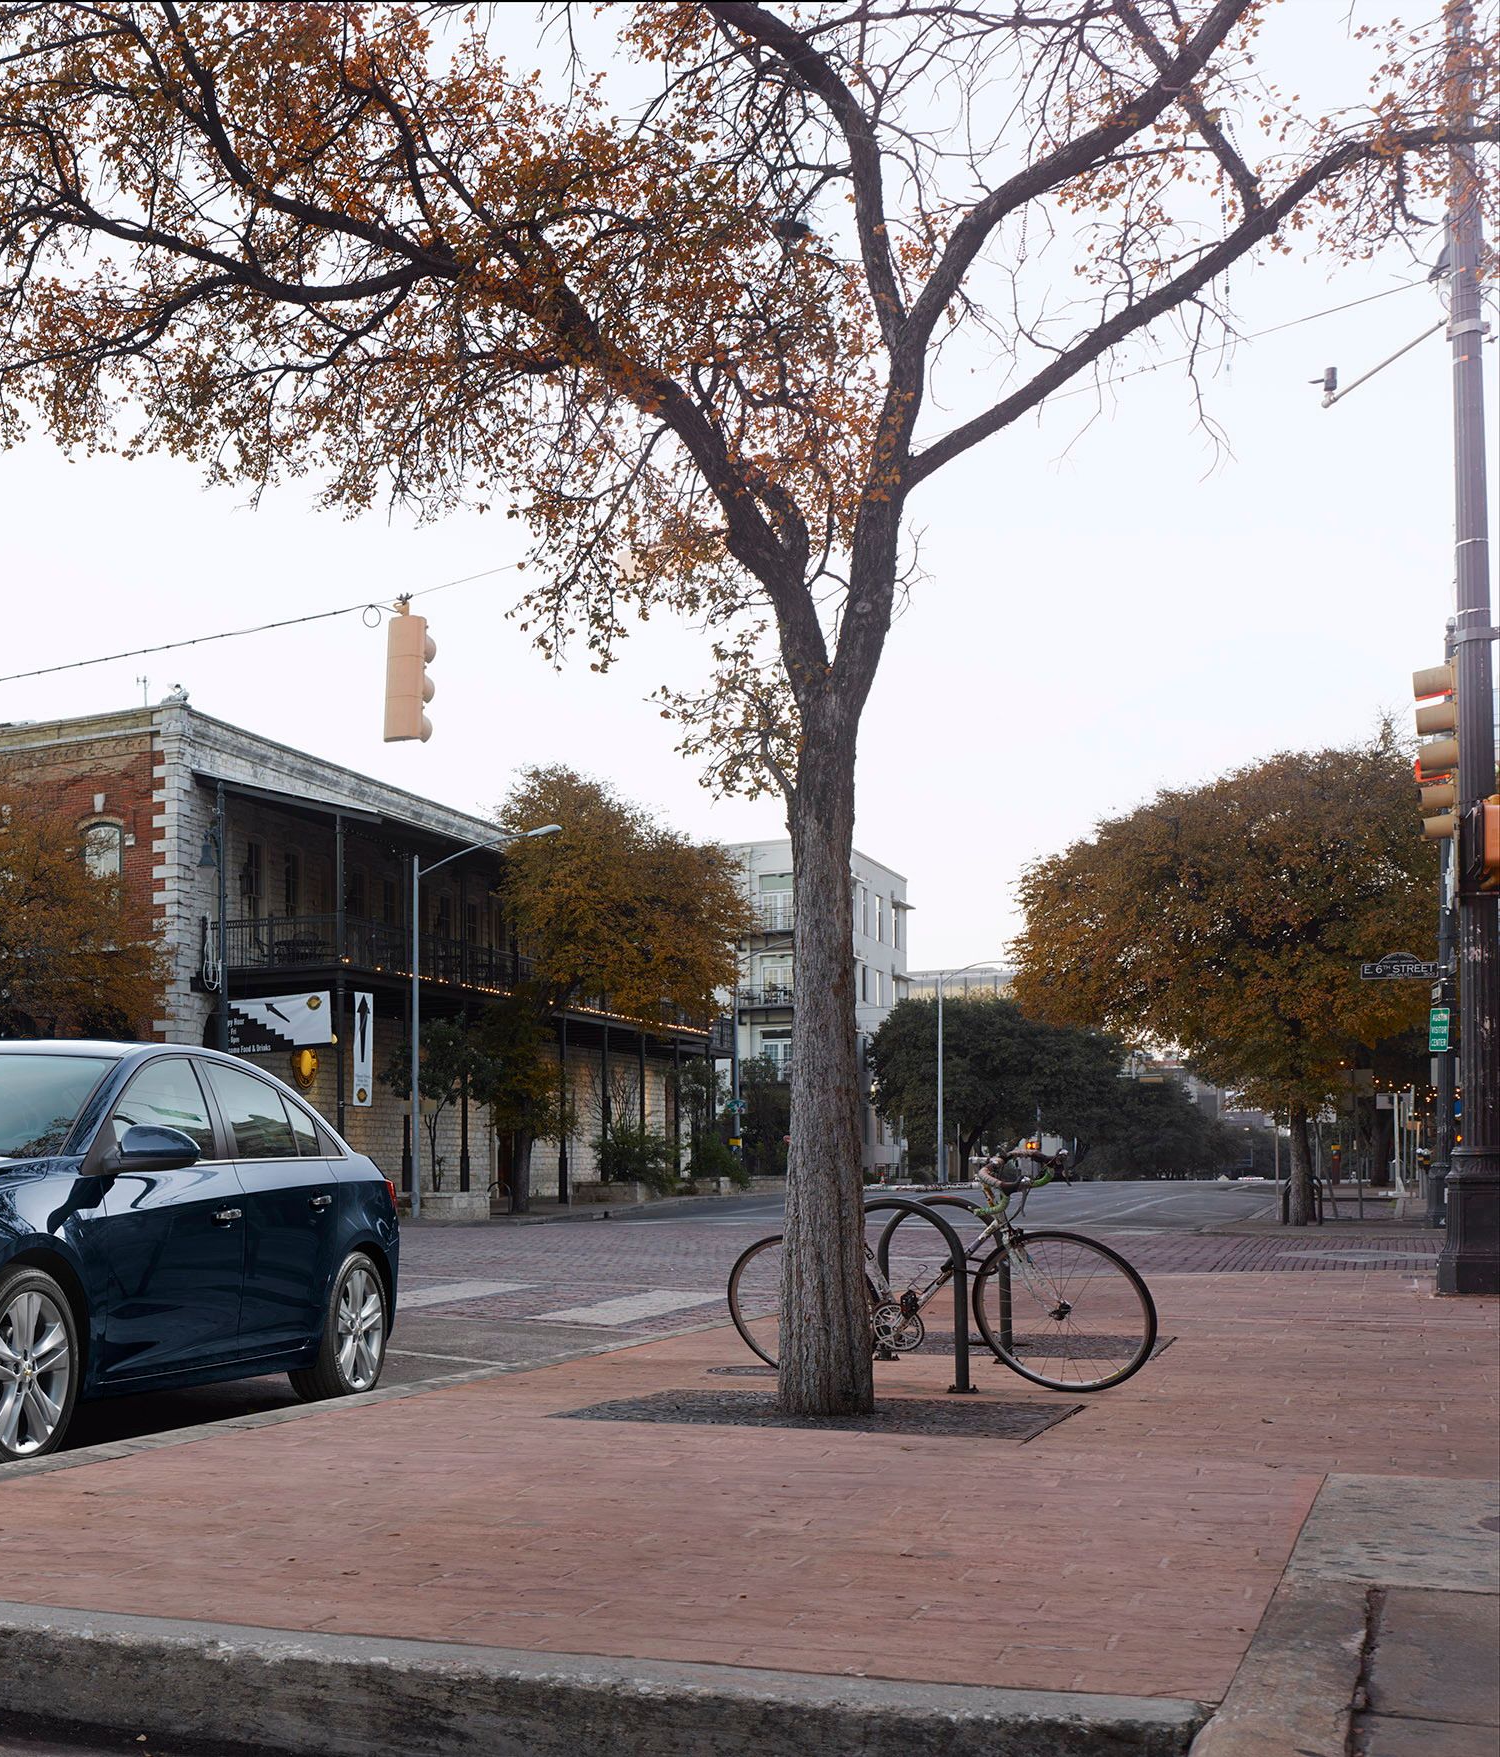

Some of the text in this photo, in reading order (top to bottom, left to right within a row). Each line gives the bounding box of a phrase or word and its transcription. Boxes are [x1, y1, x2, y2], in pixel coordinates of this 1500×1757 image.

[1375, 964, 1391, 974] 6TH
[1392, 964, 1435, 973] STREET
[240, 1045, 251, 1053] Food
[256, 1043, 271, 1052] Drinks
